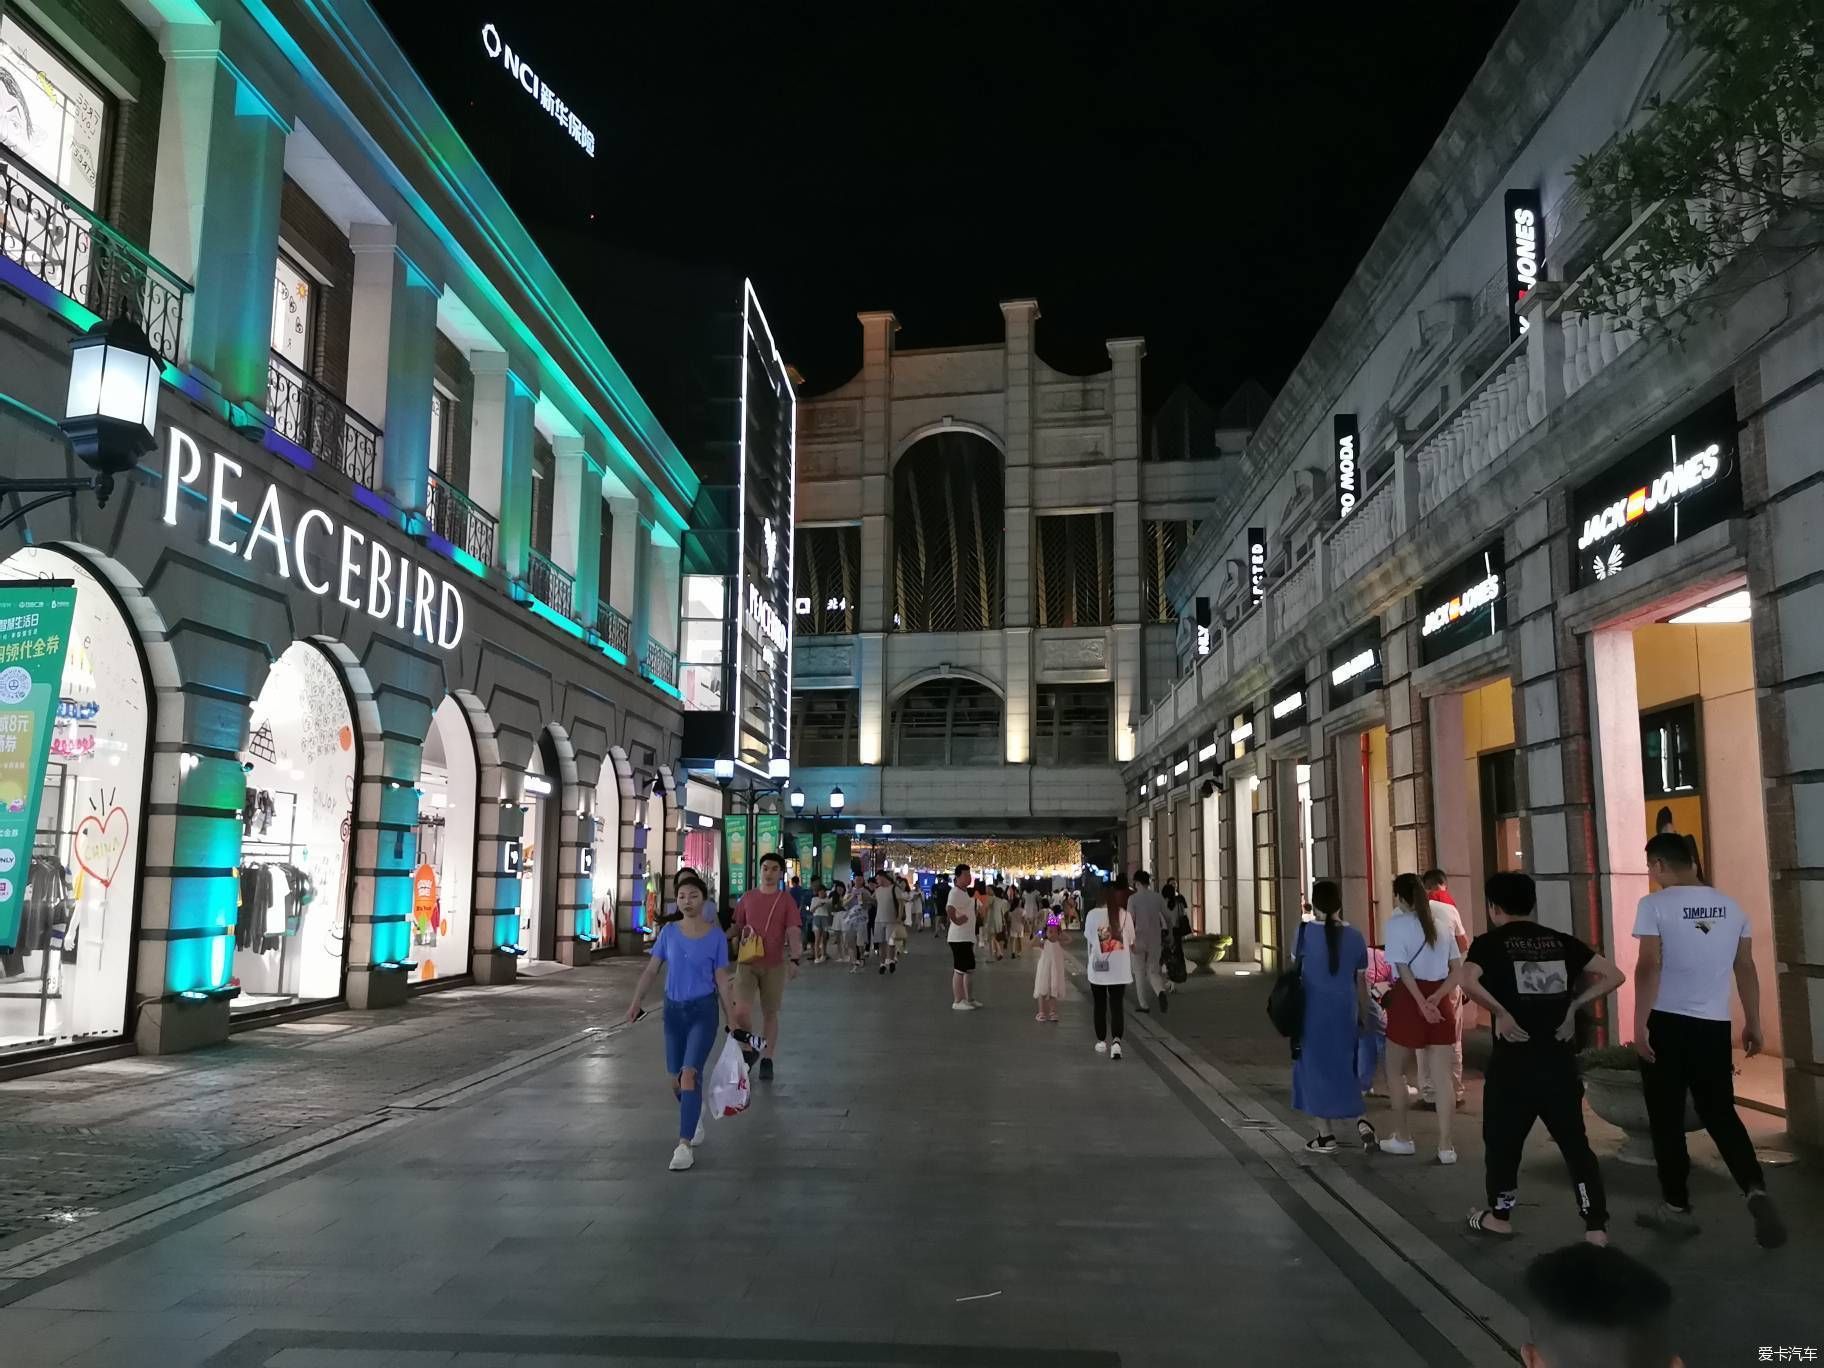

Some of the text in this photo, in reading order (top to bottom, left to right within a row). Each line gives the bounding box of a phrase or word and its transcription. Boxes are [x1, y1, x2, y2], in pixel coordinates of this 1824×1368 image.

[504, 43, 595, 158] NCI 新华保险
[1514, 208, 1537, 291] JONES
[1339, 434, 1356, 491] MODA
[1578, 443, 1720, 550] JACK JONES
[162, 426, 464, 650] PEACEBIRD
